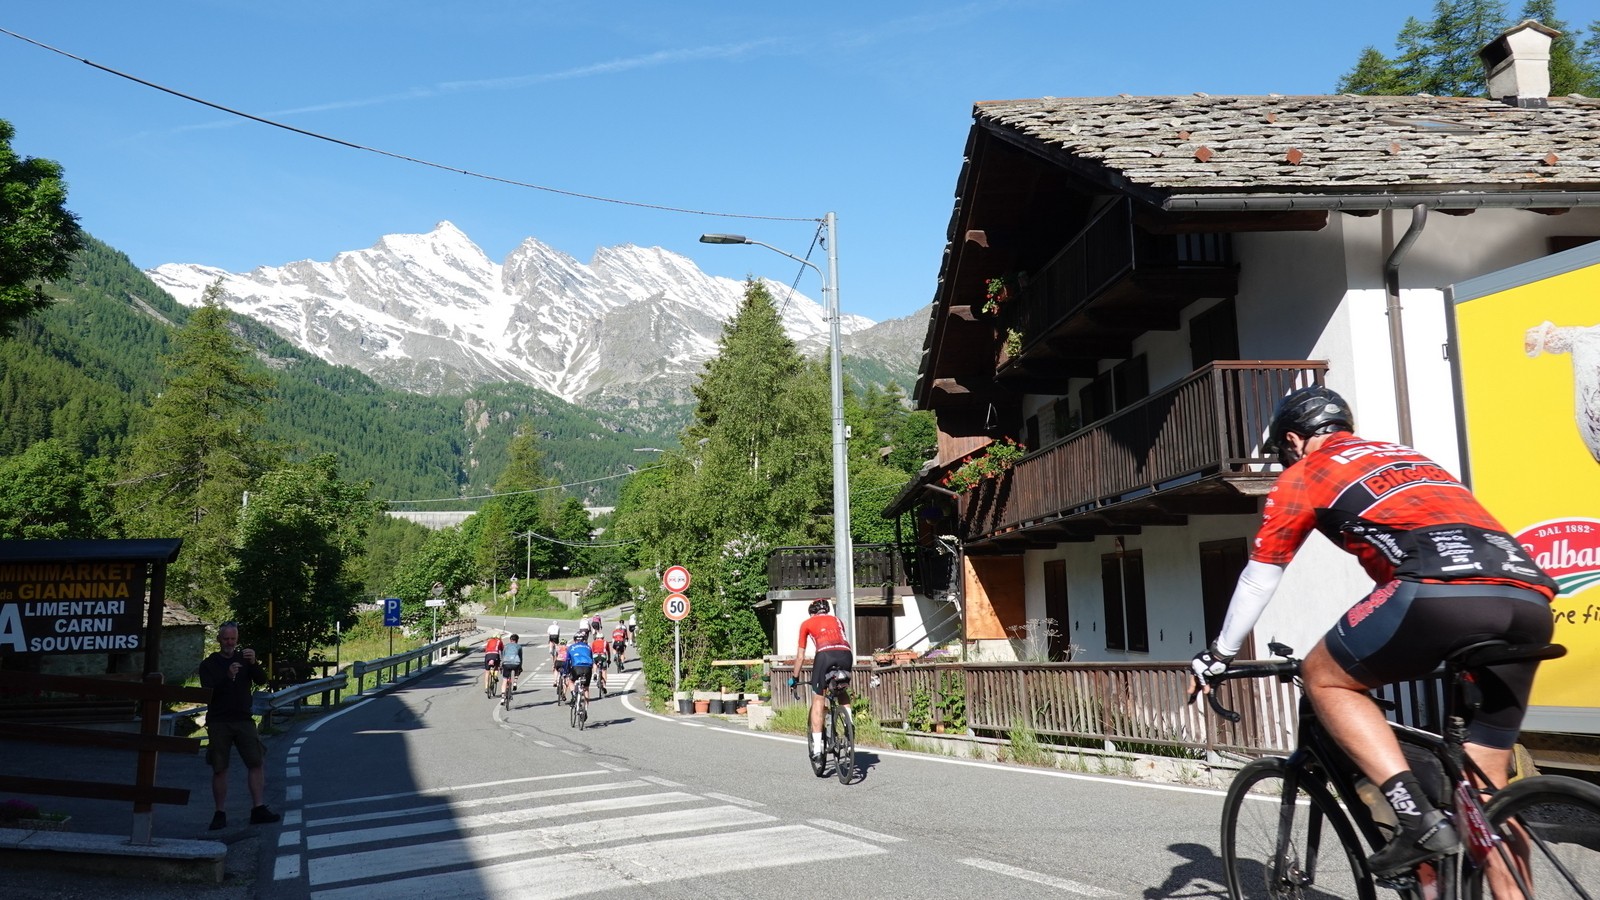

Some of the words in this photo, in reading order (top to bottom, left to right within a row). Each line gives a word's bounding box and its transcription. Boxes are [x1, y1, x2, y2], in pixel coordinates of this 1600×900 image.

[1521, 539, 1600, 570] alba
[0, 564, 136, 582] MINIMARKET
[18, 582, 130, 600] GIANNINA
[388, 600, 398, 614] P
[670, 600, 685, 614] 50
[1552, 608, 1576, 624] re
[54, 618, 113, 633] CARNI
[30, 635, 139, 652] SOUVENIRS
